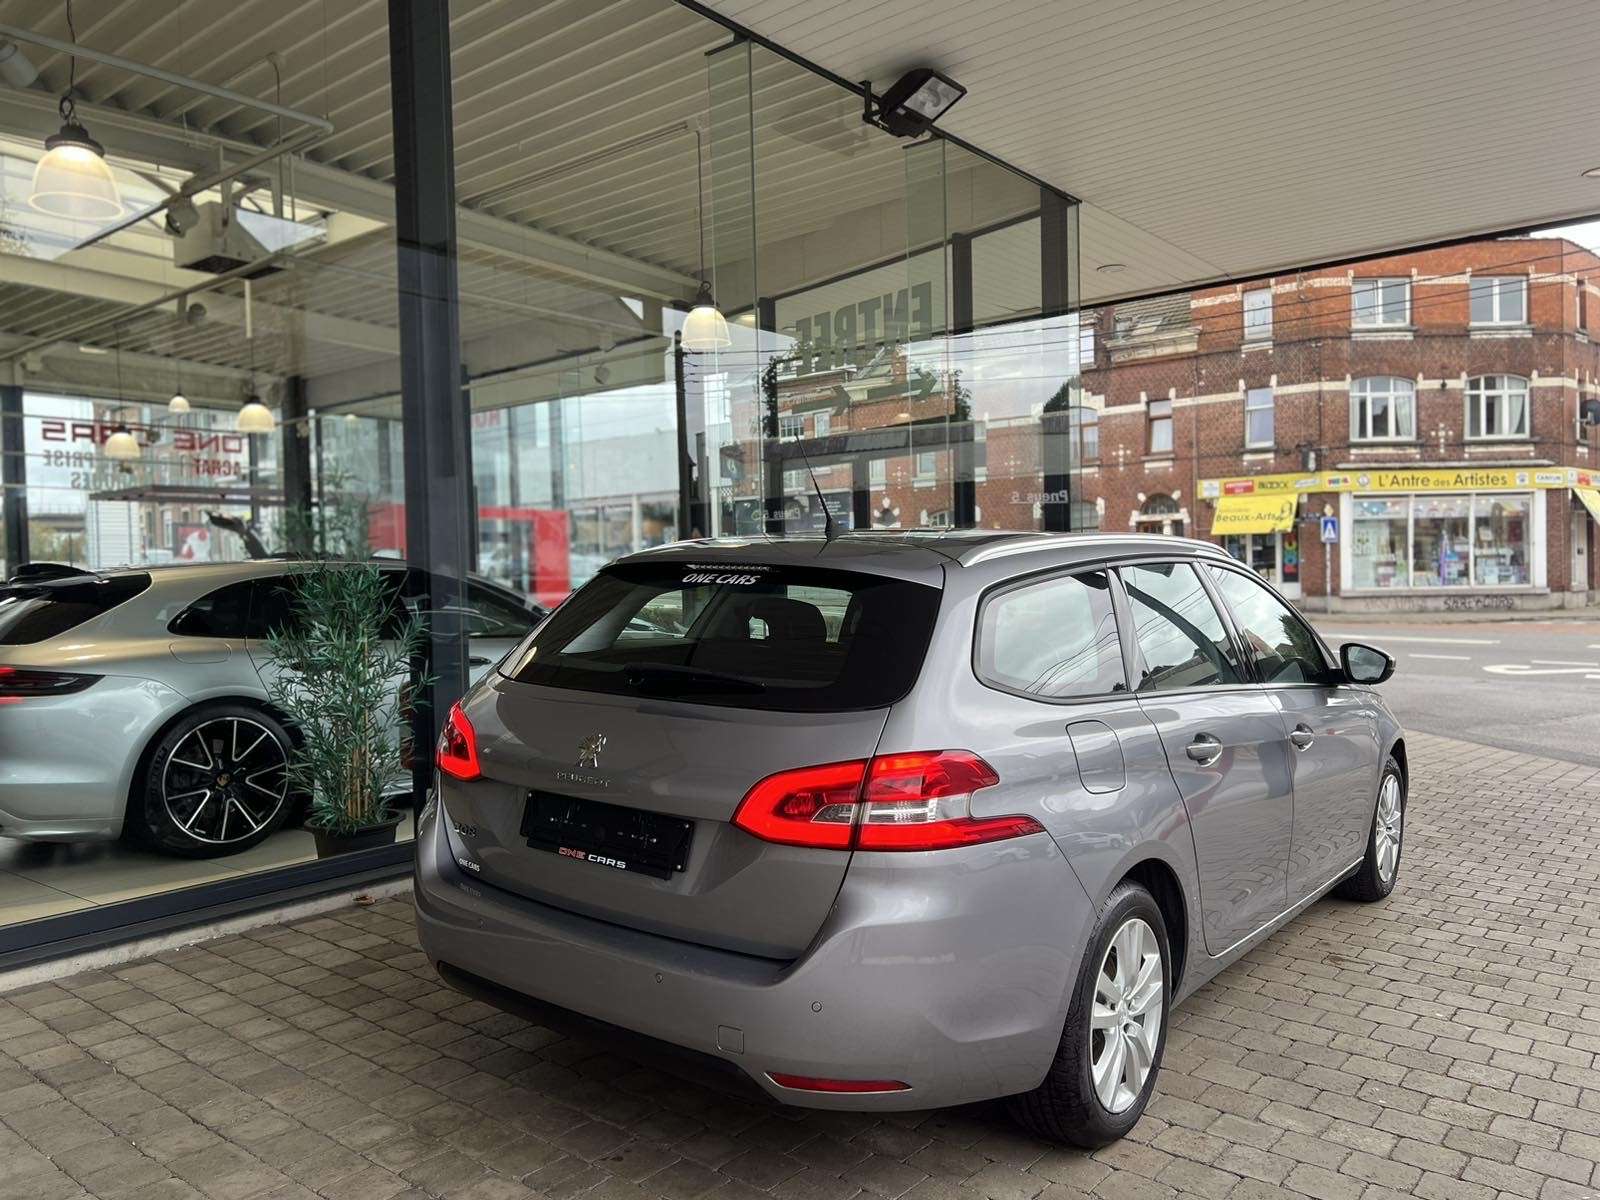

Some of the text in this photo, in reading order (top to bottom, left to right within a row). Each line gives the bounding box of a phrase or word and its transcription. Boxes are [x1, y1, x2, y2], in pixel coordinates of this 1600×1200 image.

[1378, 472, 1508, 488] L'Antre des Artistes
[682, 573, 761, 585] ONE CARS
[559, 846, 627, 869] ONE CARS
